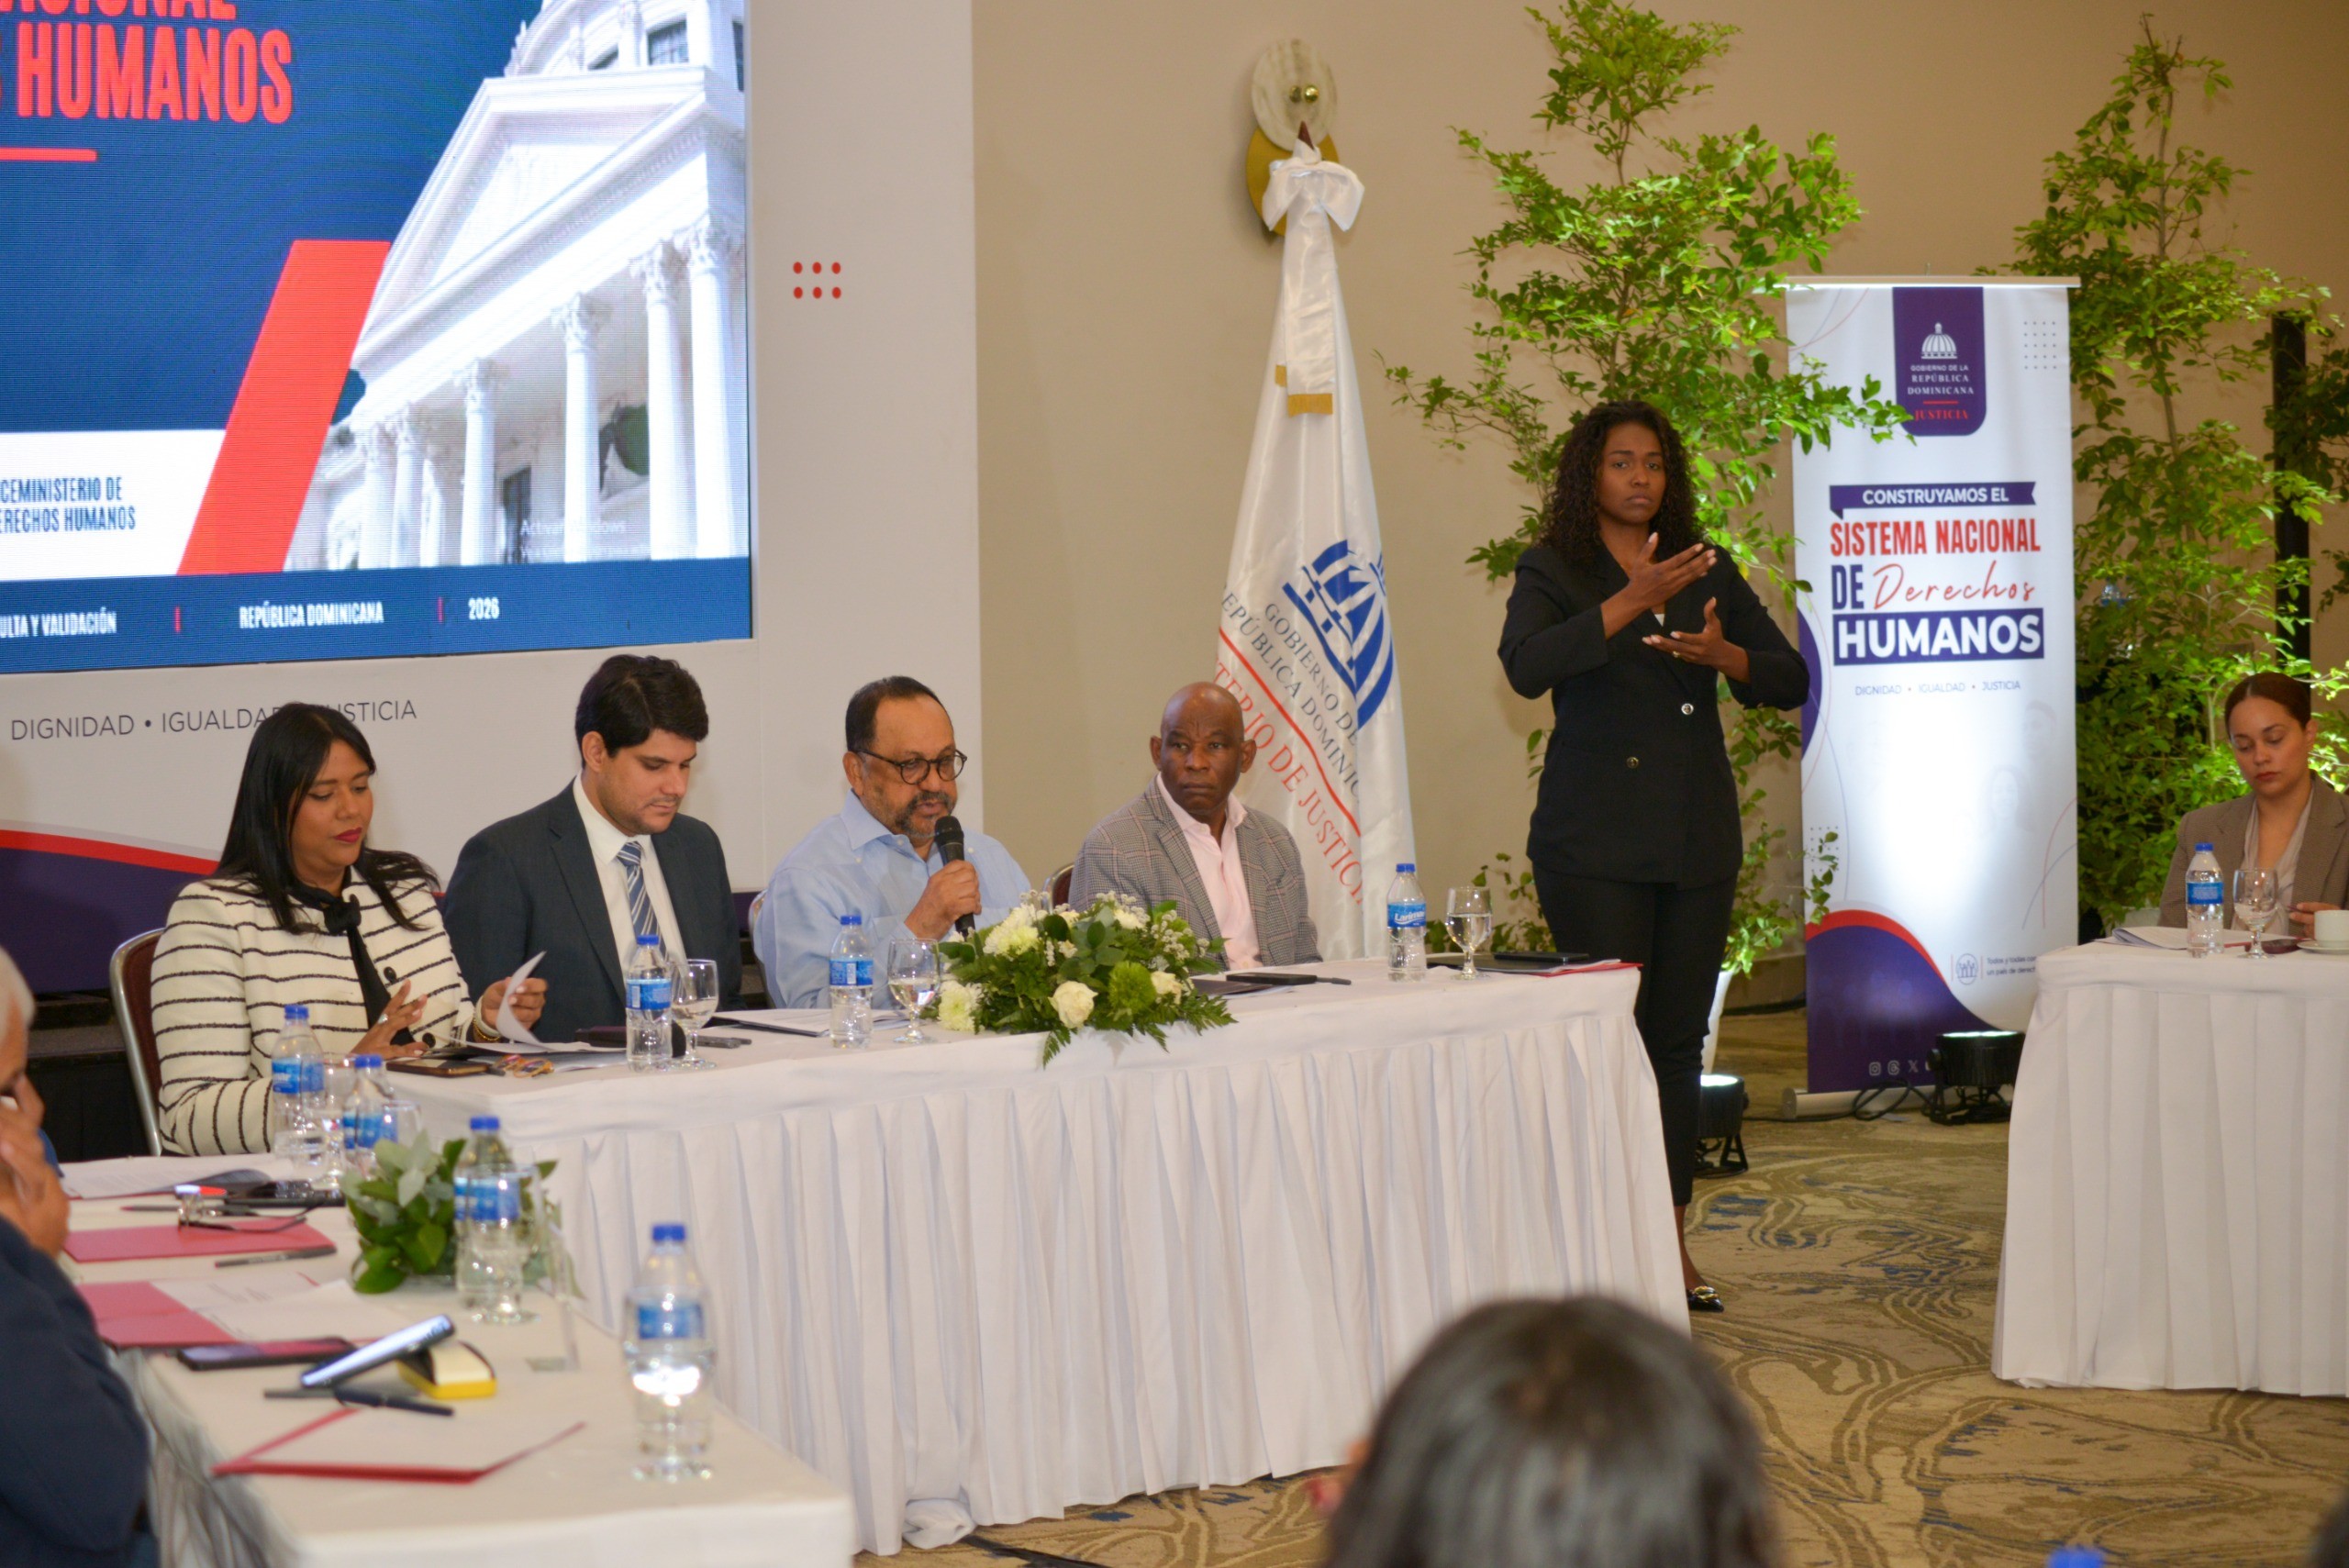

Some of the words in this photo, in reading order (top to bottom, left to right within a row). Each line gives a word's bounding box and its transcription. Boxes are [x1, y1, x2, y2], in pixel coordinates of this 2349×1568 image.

[17, 21, 293, 124] HUMANOS
[1907, 386, 1975, 395] DOMINICANA
[1911, 373, 1969, 383] REPÚBLICA
[1914, 409, 1969, 421] JUSTICIA
[106, 475, 122, 501] DE
[1863, 487, 1988, 505] CONSTRUYAMOS
[1990, 487, 2009, 503] EL
[64, 505, 136, 531] HUMANOS
[1830, 520, 1928, 557] SISTEMA
[1935, 517, 2041, 555] NACIONAL
[1831, 564, 1865, 610] DE
[1873, 560, 2035, 610] Derechos
[30, 614, 40, 637] Y
[41, 606, 117, 636] VALIDACIÓN
[239, 600, 306, 628] REPÚBLICA
[306, 601, 384, 627] DOMINICANA
[469, 597, 500, 620] 2026
[1221, 587, 1302, 699] EPÚBLICA
[1838, 615, 2042, 659] HUMANOS
[1264, 603, 1339, 712] GOBIERNO
[1335, 712, 1359, 746] DE
[1854, 684, 1902, 695] DIGNIDAD
[1918, 682, 1966, 694] IGUALDAD
[1982, 681, 2021, 691] JUSTICIA
[11, 714, 135, 740] DIGNIDAD
[161, 706, 280, 733] IGUALDA
[1268, 744, 1308, 793] DE
